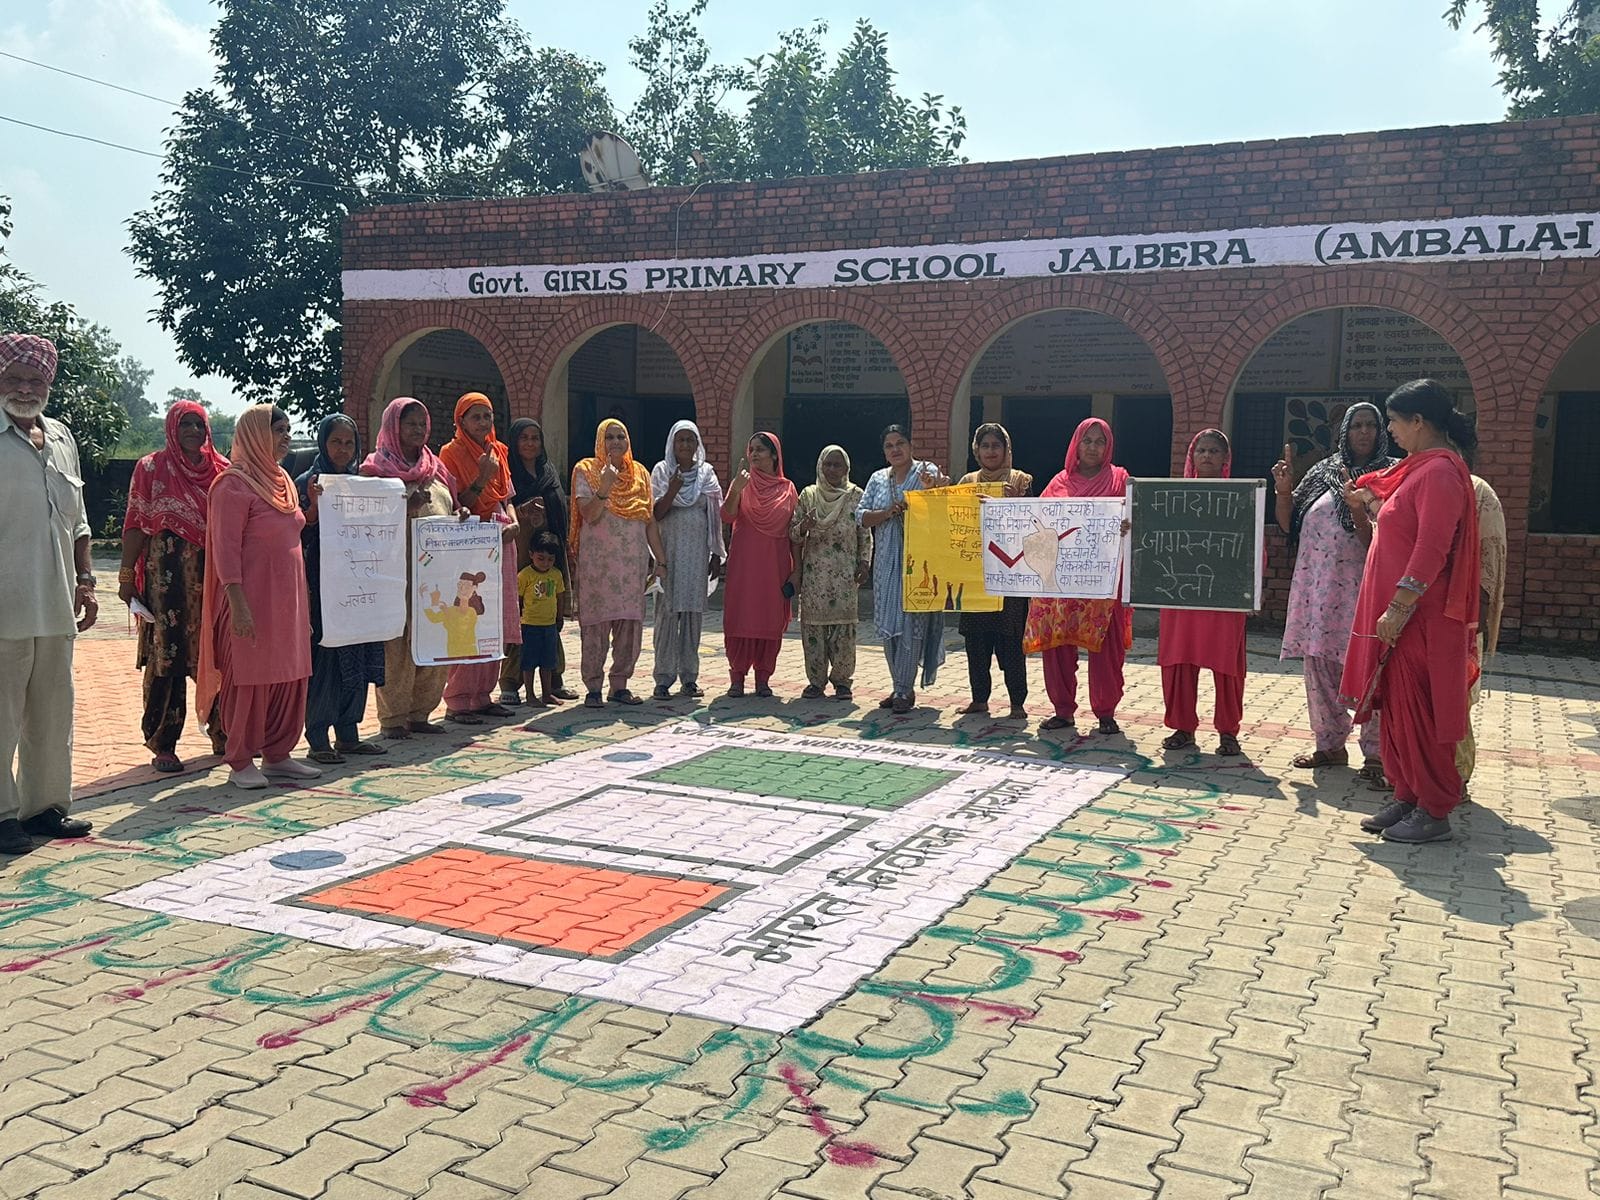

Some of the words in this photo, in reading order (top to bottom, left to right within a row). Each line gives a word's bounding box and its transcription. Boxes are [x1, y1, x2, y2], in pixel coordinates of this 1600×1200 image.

[469, 271, 529, 295] Govt.
[543, 268, 627, 292] GIRLS
[644, 261, 807, 289] PRIMARY
[834, 252, 1006, 284] SCHOOL
[1048, 239, 1256, 274] JALBERA
[1314, 219, 1600, 265] (AMBALA-I
[672, 726, 753, 741] INDIA
[799, 738, 946, 760] COMMISSION
[954, 752, 1077, 775] ELECTION
[721, 891, 871, 963] भारत
[827, 824, 973, 891] निर्वाचन
